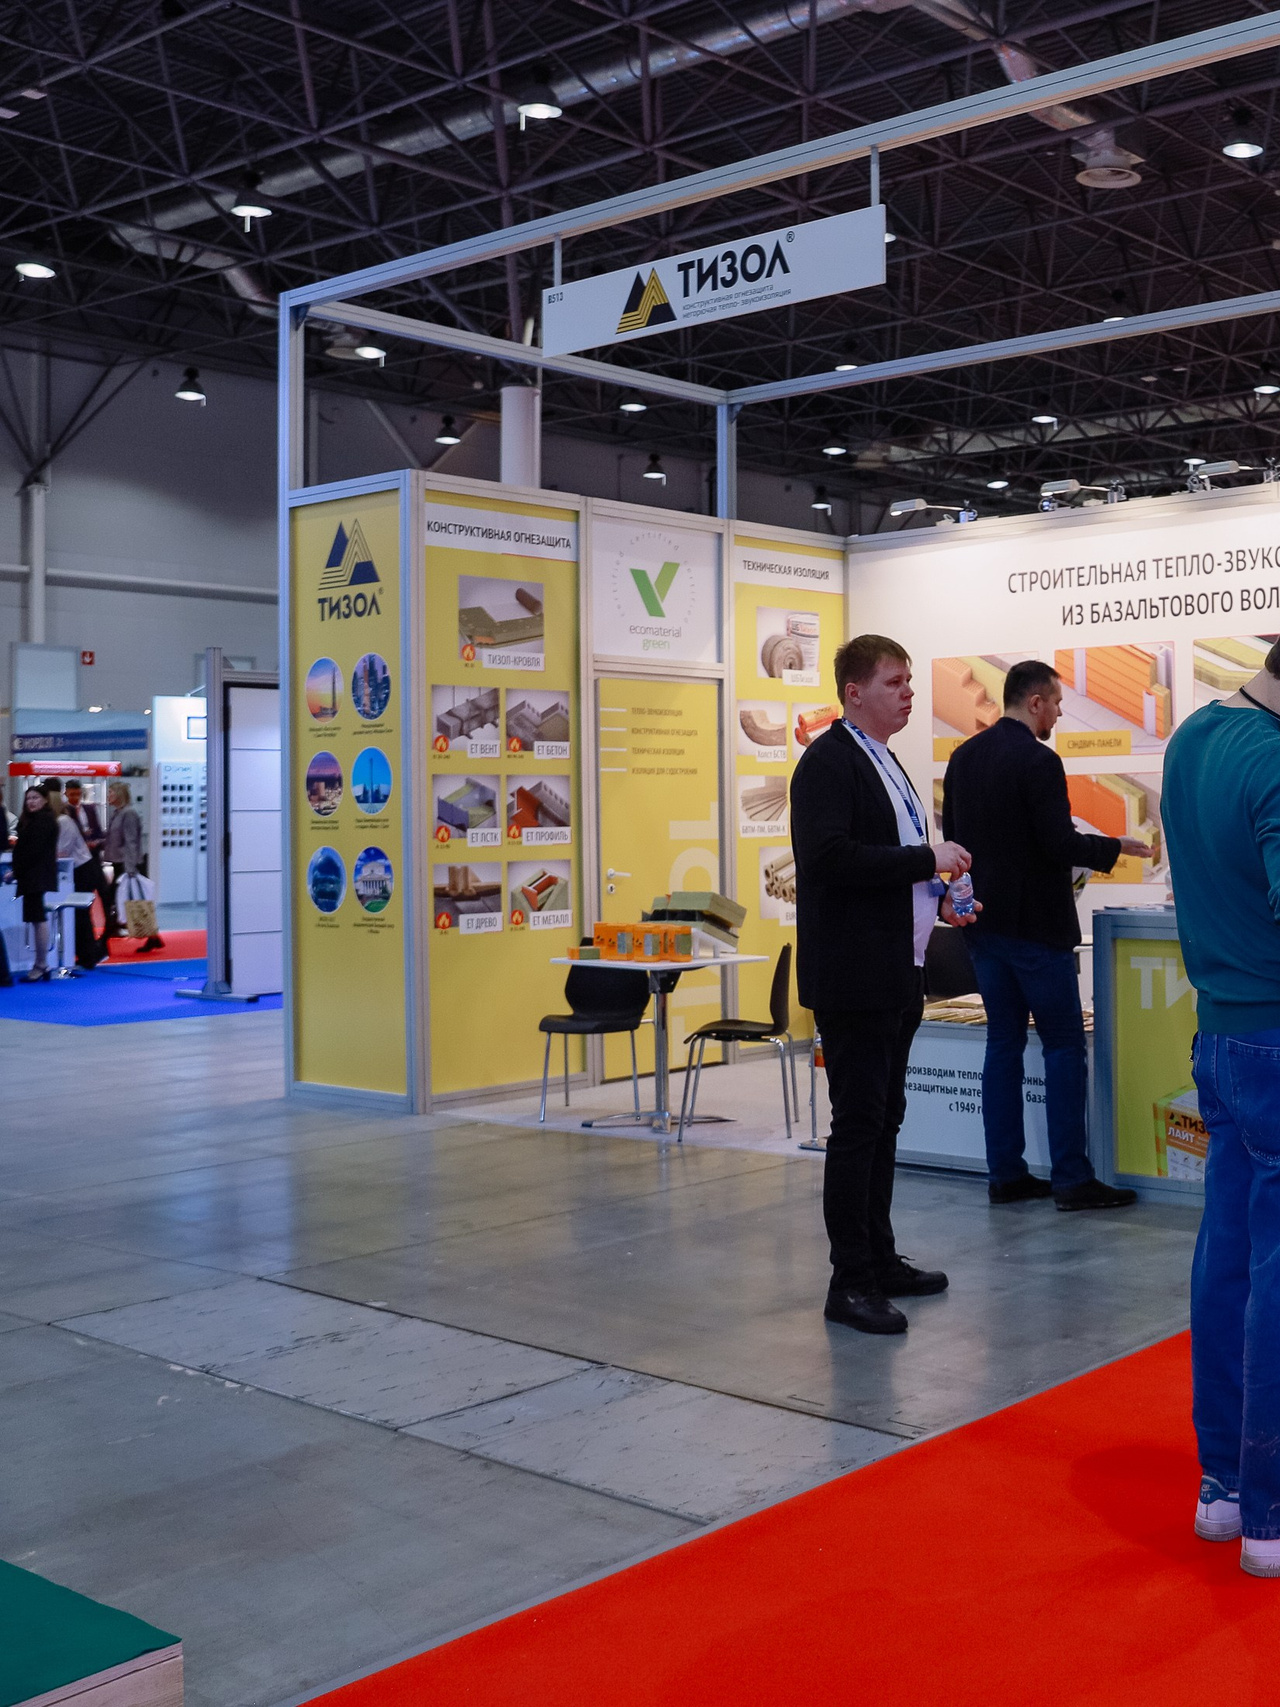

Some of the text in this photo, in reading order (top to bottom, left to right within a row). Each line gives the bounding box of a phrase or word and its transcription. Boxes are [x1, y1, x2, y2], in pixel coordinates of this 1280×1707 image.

[677, 239, 791, 298] ТИЗОЛ
[427, 520, 571, 549] КОНСТРУКТИВНАЯ ОГНЕЗАЩИТА
[743, 559, 830, 580] ТЕХНИЧЕСКАЯ ИЗОЛЯЦИЯ
[1007, 559, 1147, 594] СТРОИТЕЛЬНАЯ
[318, 592, 381, 622] ТИЗОЛ
[1061, 603, 1084, 626] ИЗ
[1090, 591, 1233, 624] БАЗАЛЬТОВОГО
[629, 624, 682, 638] ecomaterial
[642, 639, 670, 651] green
[488, 653, 541, 667] ТИЗОЛ-КРОВЛЯ
[546, 745, 568, 755] БЕТОН
[1067, 738, 1122, 750] СЭНДВИЧ-ПАНЕЛИ
[535, 830, 569, 841] ПРОФИЛЬ
[542, 914, 569, 925] МЕТАЛЛ
[906, 1064, 955, 1078] роизводим
[955, 1101, 975, 1114] 1949
